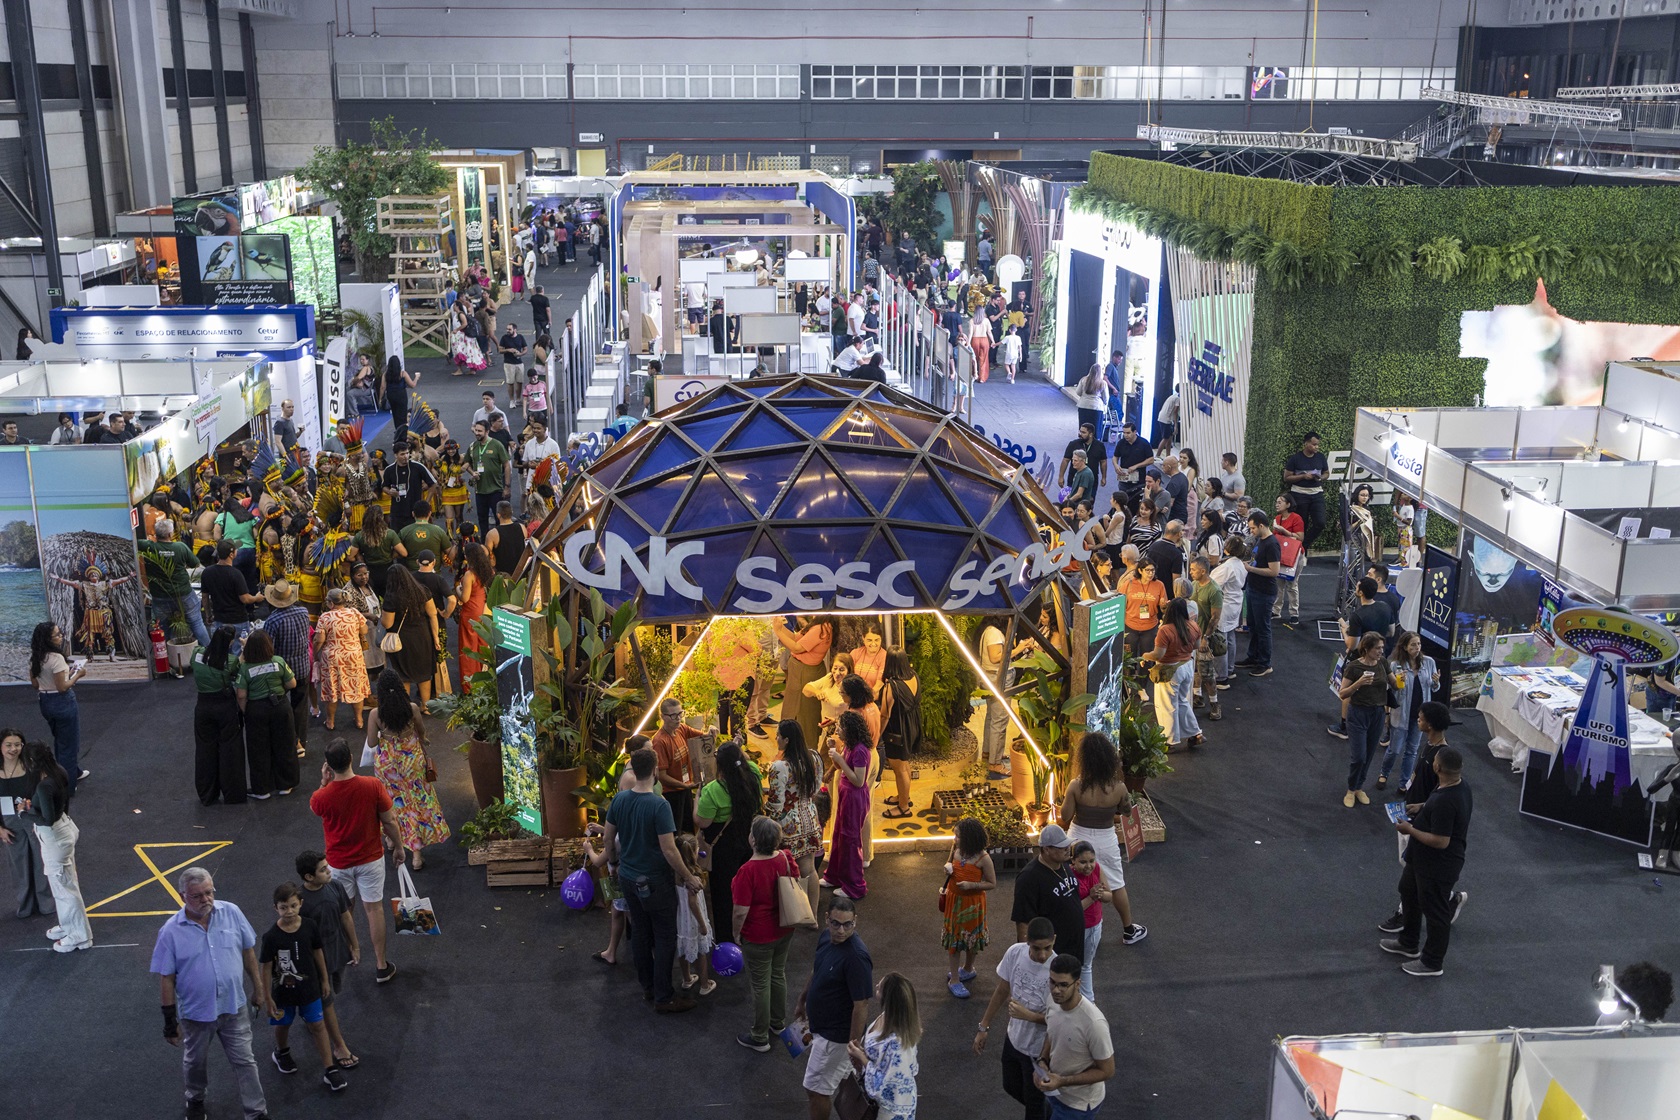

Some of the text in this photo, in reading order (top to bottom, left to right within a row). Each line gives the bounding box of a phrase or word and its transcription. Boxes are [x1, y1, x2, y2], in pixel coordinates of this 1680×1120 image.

[135, 329, 165, 338] ESPAÇO
[1187, 356, 1236, 404] SEBRAE
[563, 530, 705, 601] CNC
[1590, 720, 1614, 733] UFO
[1574, 727, 1627, 747] TURISMO
[1052, 876, 1078, 897] PARIS
